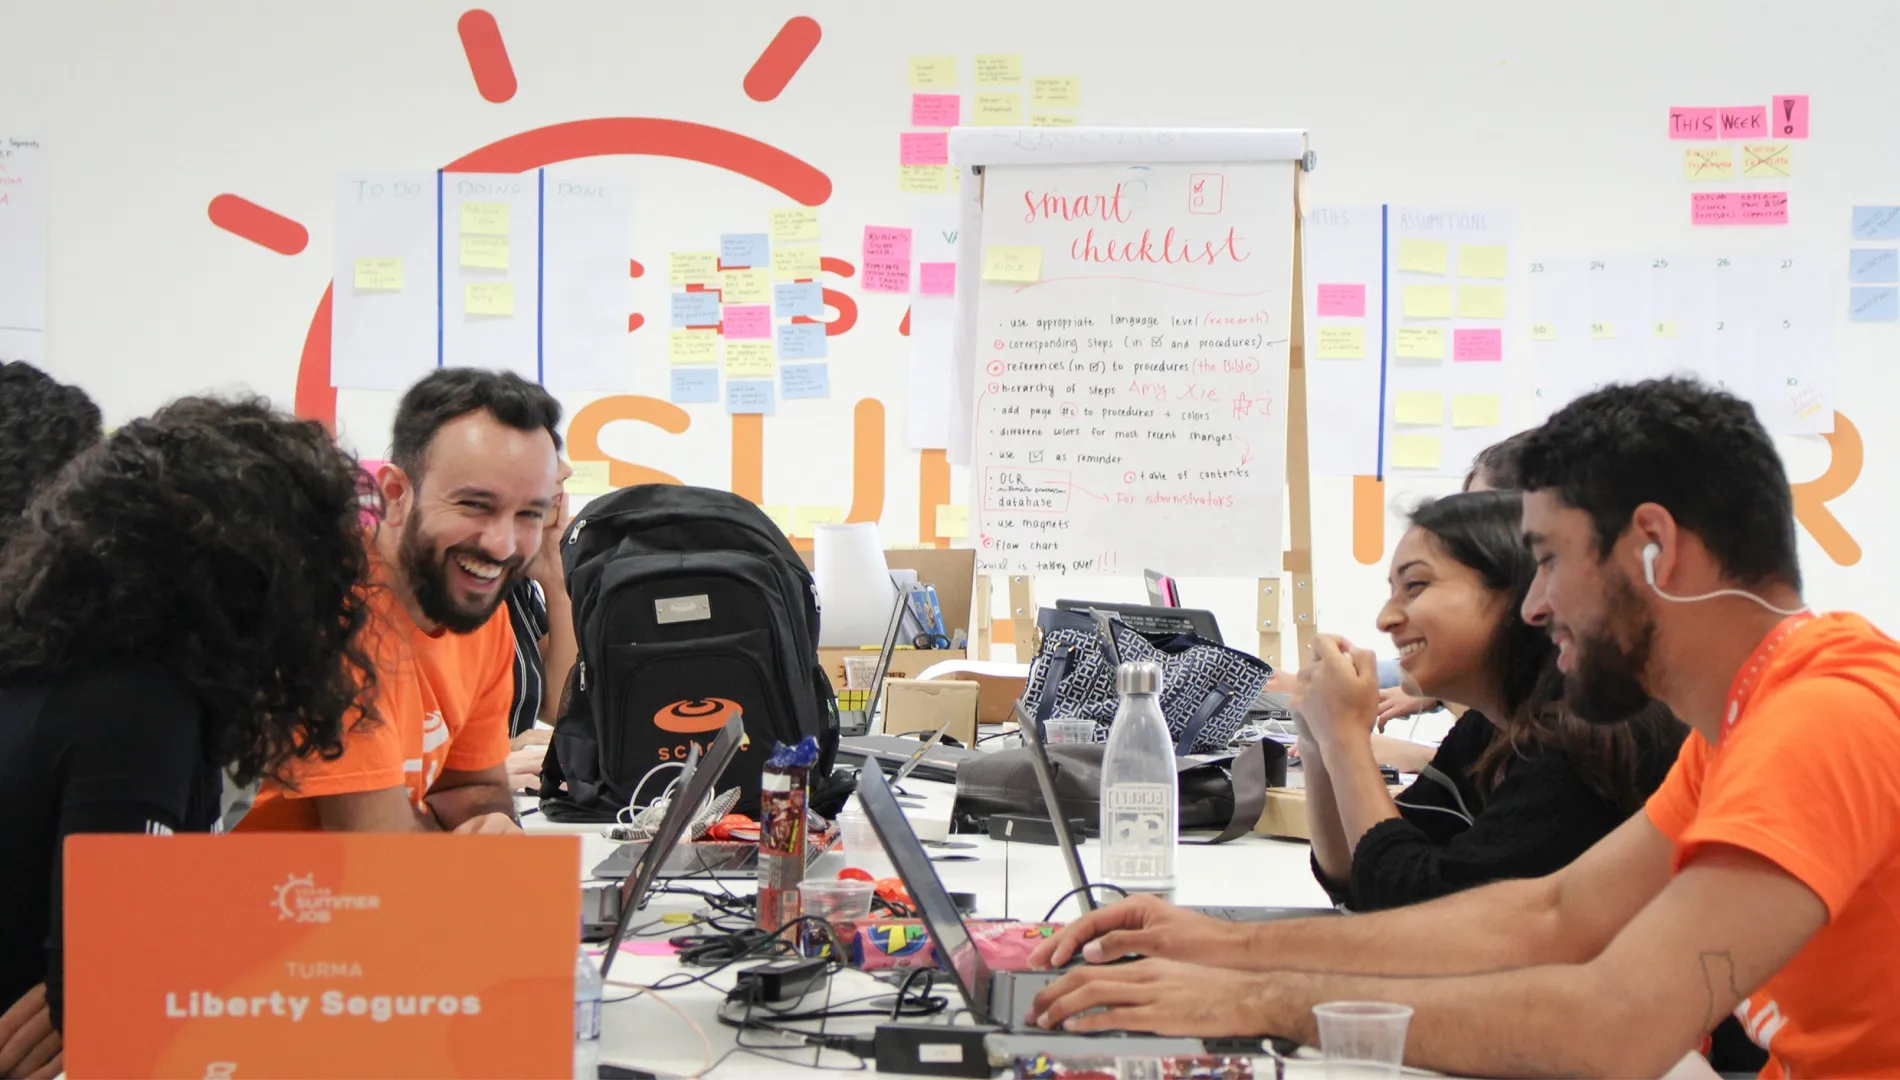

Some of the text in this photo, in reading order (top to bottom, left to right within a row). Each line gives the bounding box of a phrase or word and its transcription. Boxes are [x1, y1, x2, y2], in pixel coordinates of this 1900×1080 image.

[1671, 113, 1713, 133] THIS
[1720, 113, 1762, 131] WEEK
[393, 182, 422, 197] DO
[456, 180, 522, 196] DOING
[558, 182, 607, 198] DONE
[1024, 183, 1133, 224] smart
[1400, 213, 1487, 231] ASSUMPTIONS
[1071, 226, 1252, 265] checklist
[1530, 258, 1793, 273] 23 24 25 26 27
[1010, 311, 1270, 330] use appropriate language level (research)
[1717, 321, 1725, 331] 2
[1008, 337, 1078, 354] corresponding
[1171, 339, 1190, 349] and
[1199, 333, 1263, 349] procedures)
[1007, 360, 1065, 372] references
[1112, 362, 1124, 372] to
[1134, 360, 1190, 374] procedures
[1223, 356, 1260, 374] Bible)
[1786, 377, 1797, 386] 10
[1001, 382, 1055, 397] hierarchy
[1066, 383, 1077, 394] of
[1128, 380, 1167, 400] Amy
[1176, 383, 1221, 401] Xie
[1001, 405, 1019, 414] add
[1030, 407, 1052, 420] page
[1084, 407, 1094, 417] to
[1102, 406, 1154, 419] procedures
[1182, 409, 1210, 422] colors
[1000, 427, 1233, 447] different colors for most recent changes
[999, 451, 1123, 465] use as reminder
[999, 472, 1026, 485] OCR
[1140, 469, 1250, 481] table of contents
[998, 495, 1052, 508] database
[1145, 491, 1234, 507] administrators
[997, 518, 1070, 532] use magnets
[995, 539, 1059, 550] flow chart
[1018, 561, 1028, 570] is
[1036, 558, 1067, 576] taking
[1073, 558, 1095, 571] over
[286, 962, 363, 979] TURMA
[165, 990, 482, 1022] Liberty Seguros
